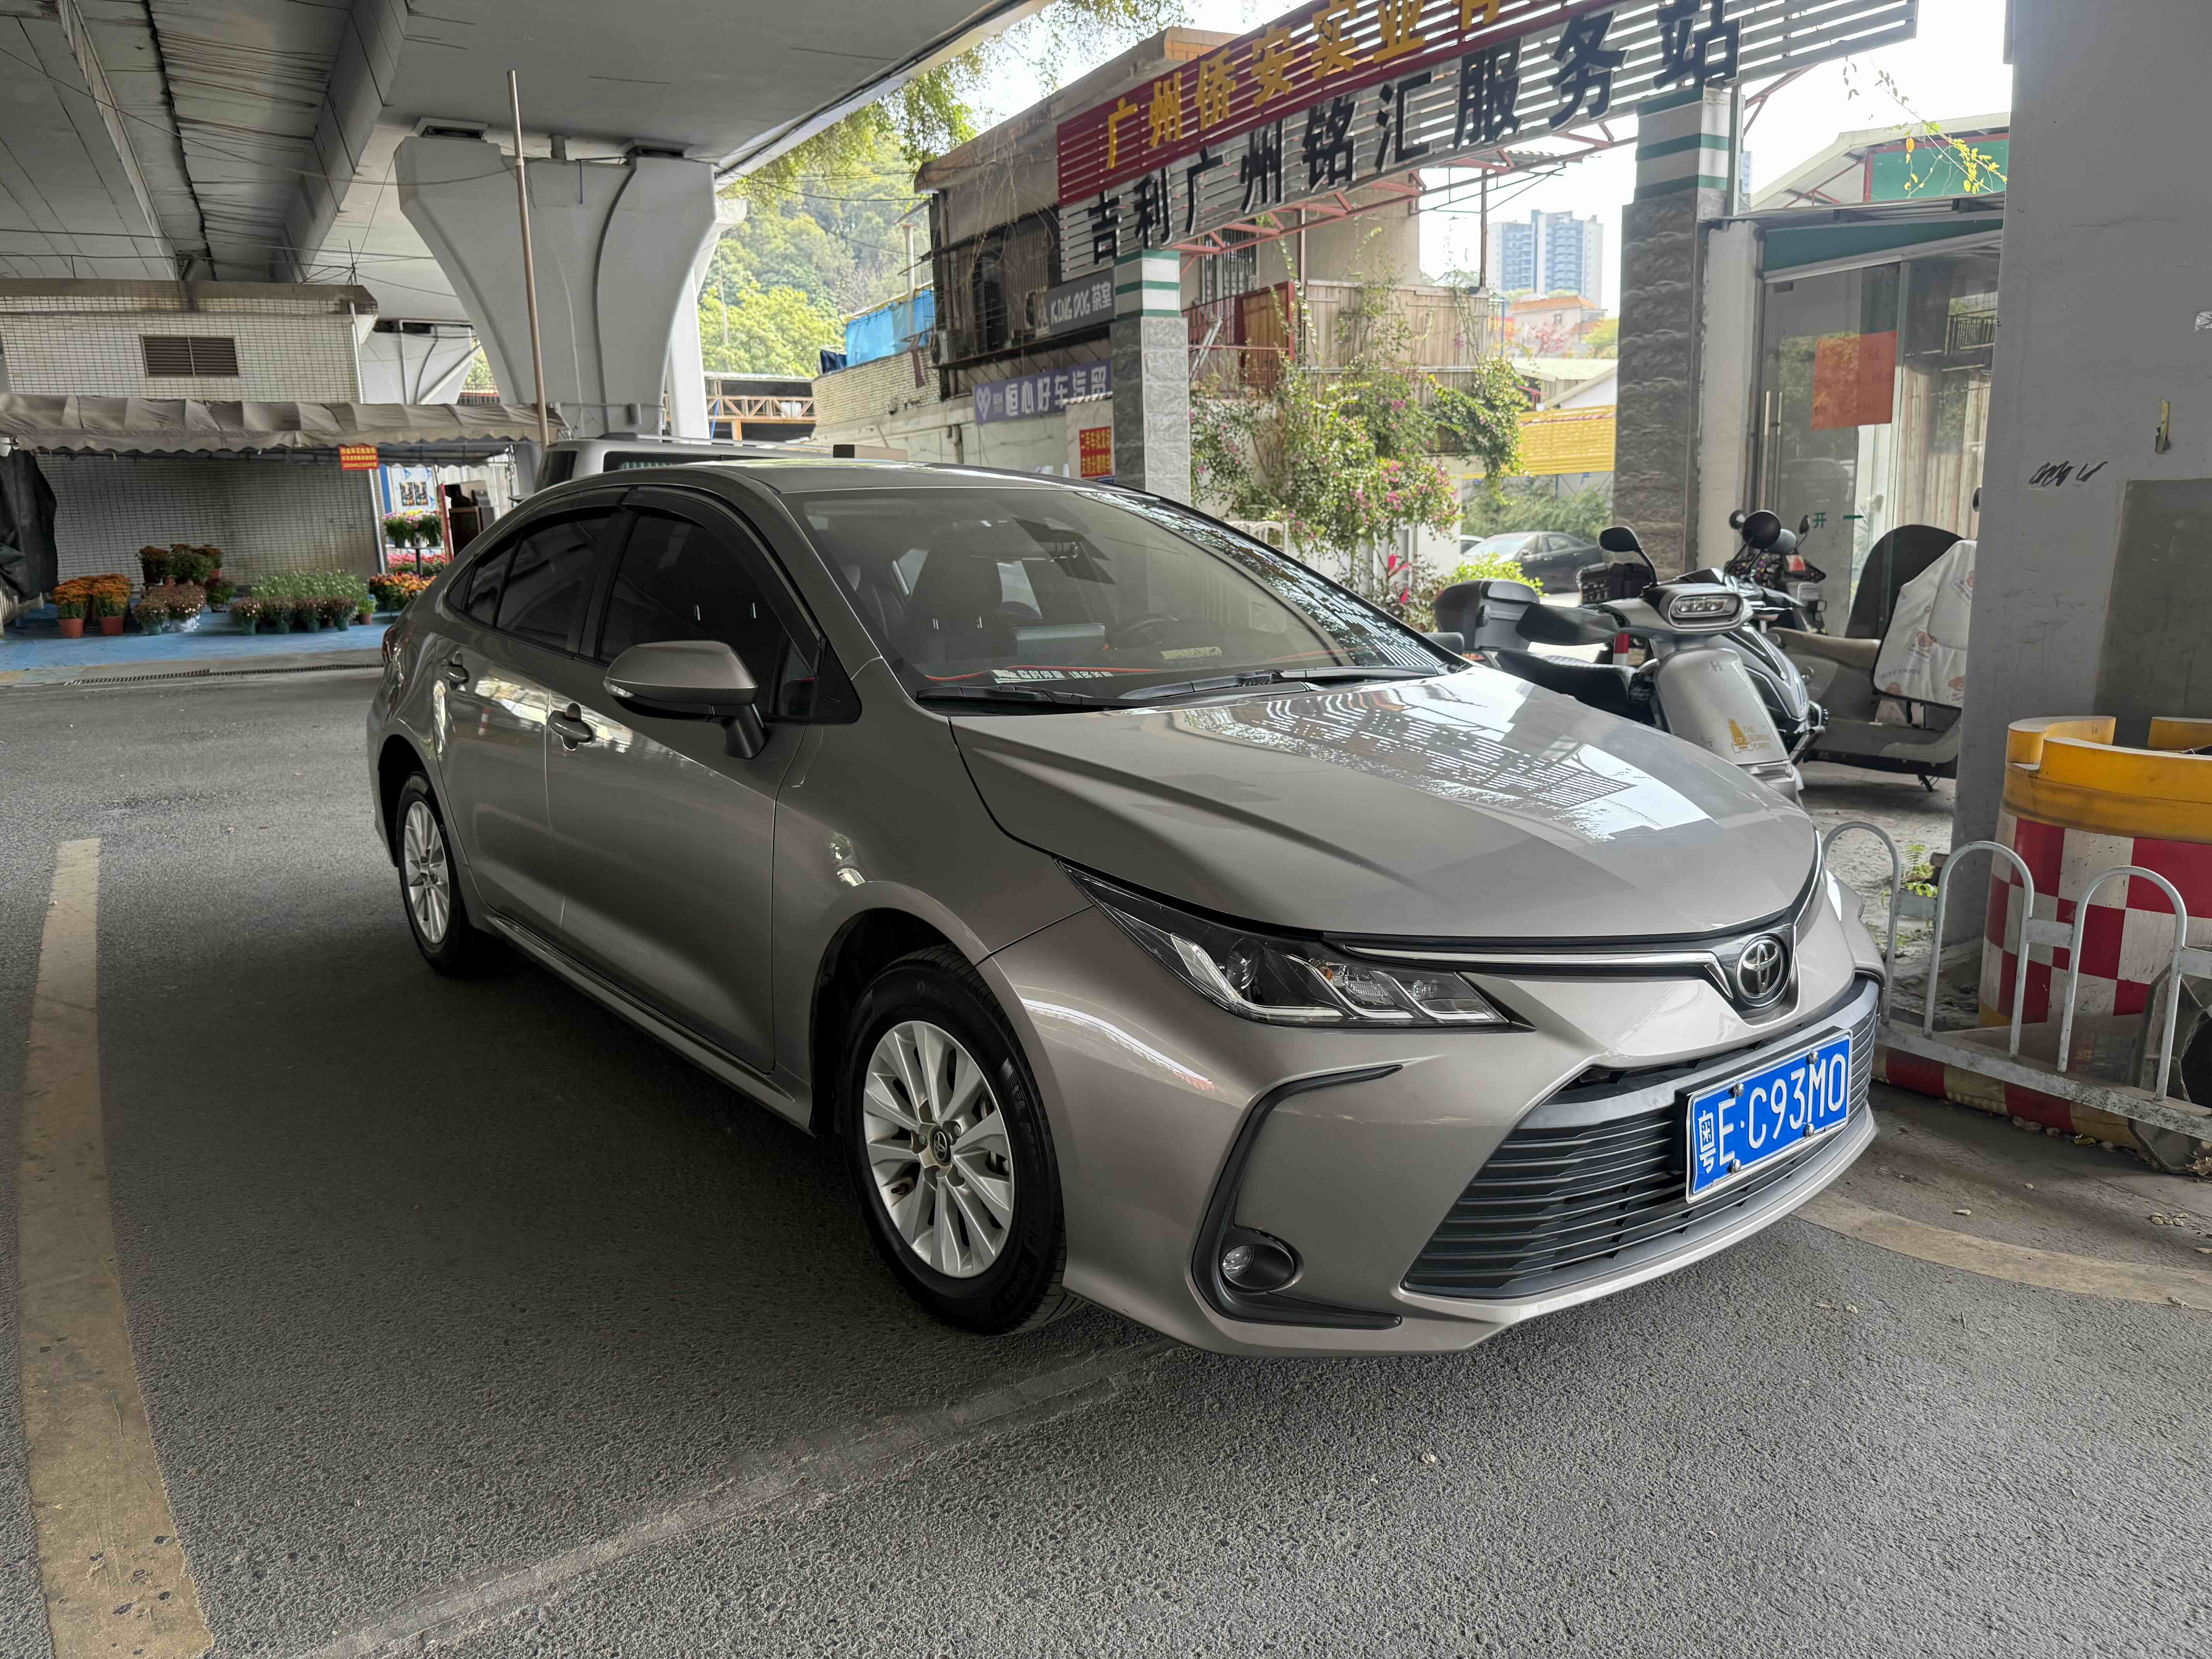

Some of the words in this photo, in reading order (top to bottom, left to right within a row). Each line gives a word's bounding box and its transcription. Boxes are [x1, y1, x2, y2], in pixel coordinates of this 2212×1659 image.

[1088, 0, 1741, 265] 吉利广州铭汇服务站
[1812, 512, 1826, 529] 开
